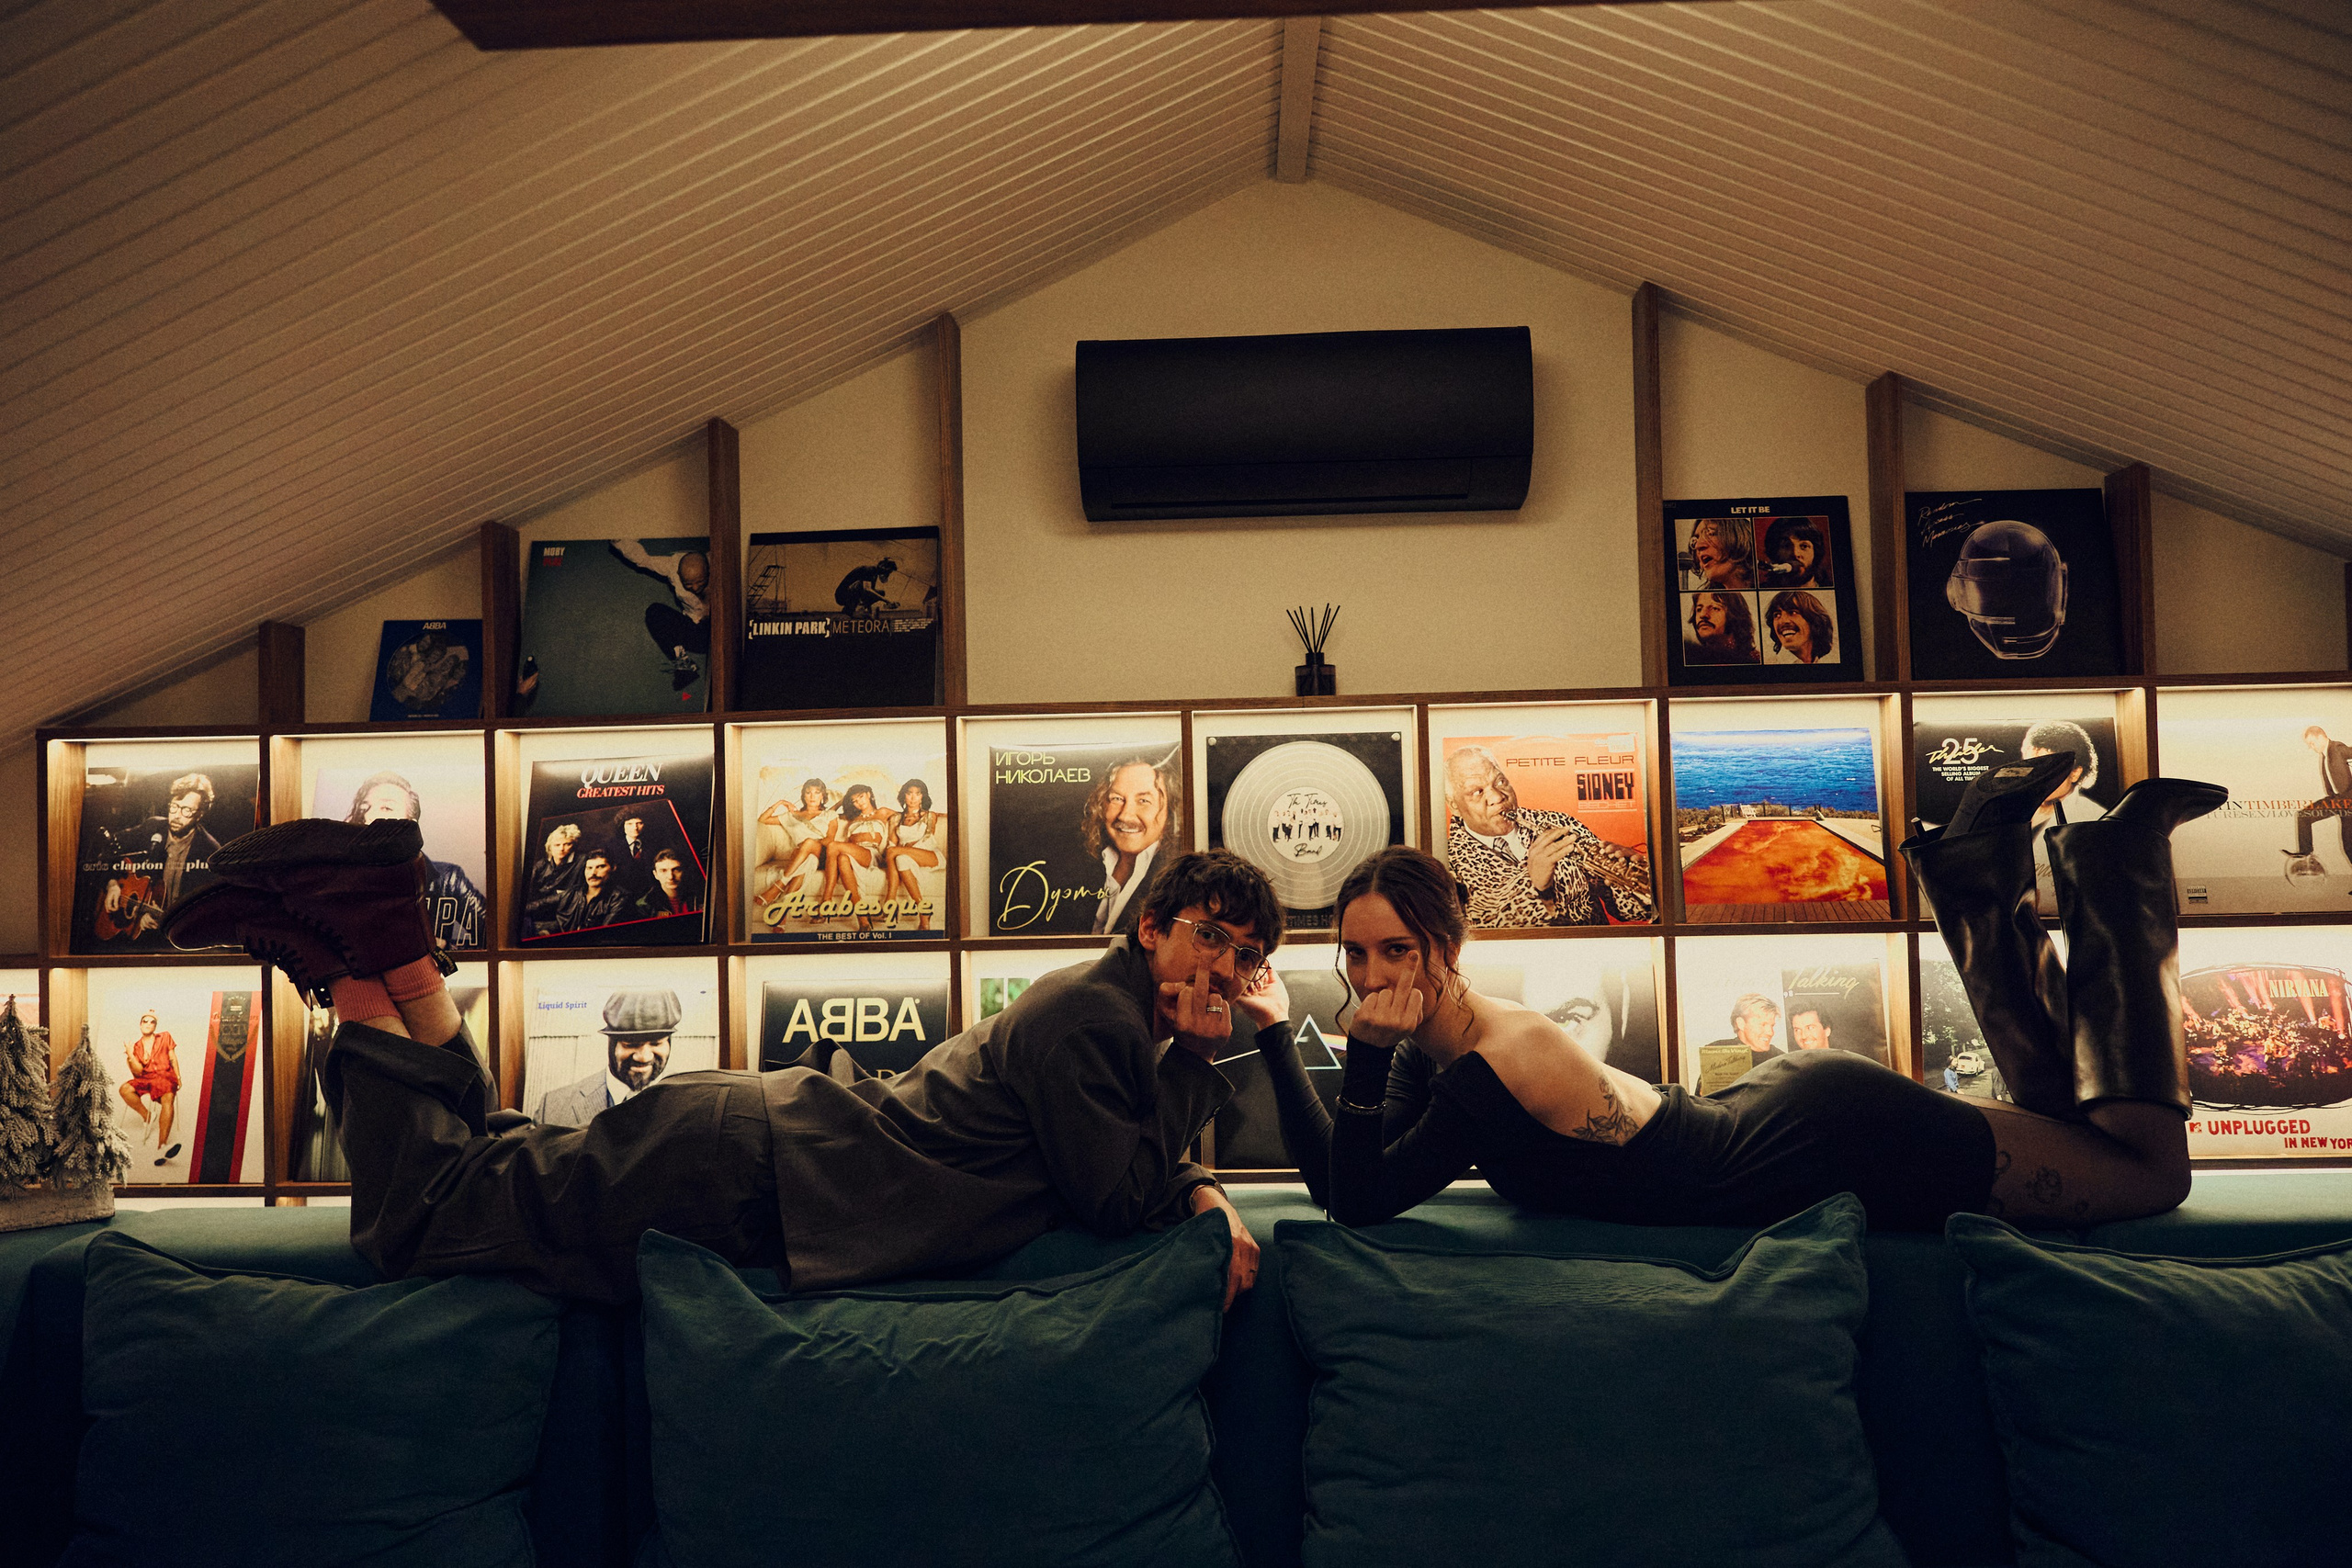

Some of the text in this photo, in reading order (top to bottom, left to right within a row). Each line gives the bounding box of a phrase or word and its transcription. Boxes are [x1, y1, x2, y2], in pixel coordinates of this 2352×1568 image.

[543, 547, 565, 557] MOBY
[833, 619, 889, 633] METEORA
[996, 751, 1056, 766] ИГОРЬ
[1941, 738, 1979, 764] 25
[1506, 755, 1634, 767] PETITE FLEUR
[581, 763, 662, 790] QUEEN
[996, 768, 1091, 784] НИКОЛАЕВ
[576, 785, 665, 799] GREATEST HITS
[1577, 773, 1634, 801] SIDNEY
[112, 860, 164, 874] clapton
[763, 890, 934, 929] Arabesque
[817, 932, 834, 941] THE
[859, 931, 870, 940] OF
[872, 931, 888, 940] Vol.
[1788, 966, 1860, 1000] Talking
[2267, 978, 2329, 998] NIRVANA
[565, 1001, 587, 1010] Spirit
[782, 997, 927, 1043] ABBA
[2208, 1120, 2311, 1135] UNPLUGGED
[2284, 1137, 2298, 1148] IN
[2301, 1137, 2328, 1148] NEW
